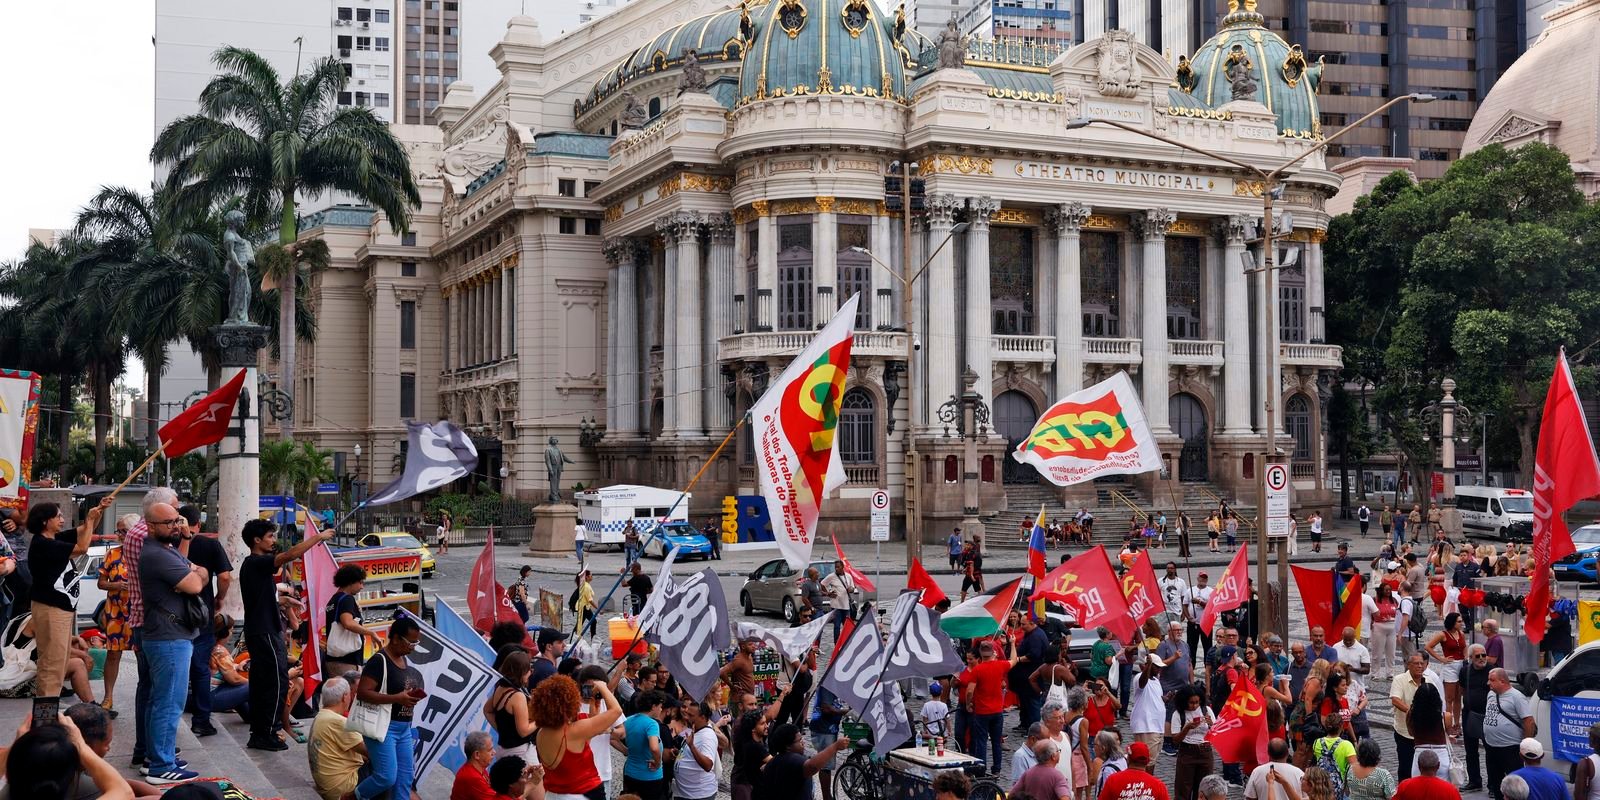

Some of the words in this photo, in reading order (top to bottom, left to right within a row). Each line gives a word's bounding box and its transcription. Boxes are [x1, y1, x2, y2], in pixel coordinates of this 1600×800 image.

[1029, 164, 1105, 182] THEATRO
[1115, 170, 1203, 190] MUNICIPAL
[1273, 471, 1281, 485] E
[778, 454, 810, 544] Trabalhadores
[877, 495, 883, 505] E
[775, 486, 786, 501] do
[782, 505, 800, 542] Brasil
[371, 561, 409, 575] SERVICE
